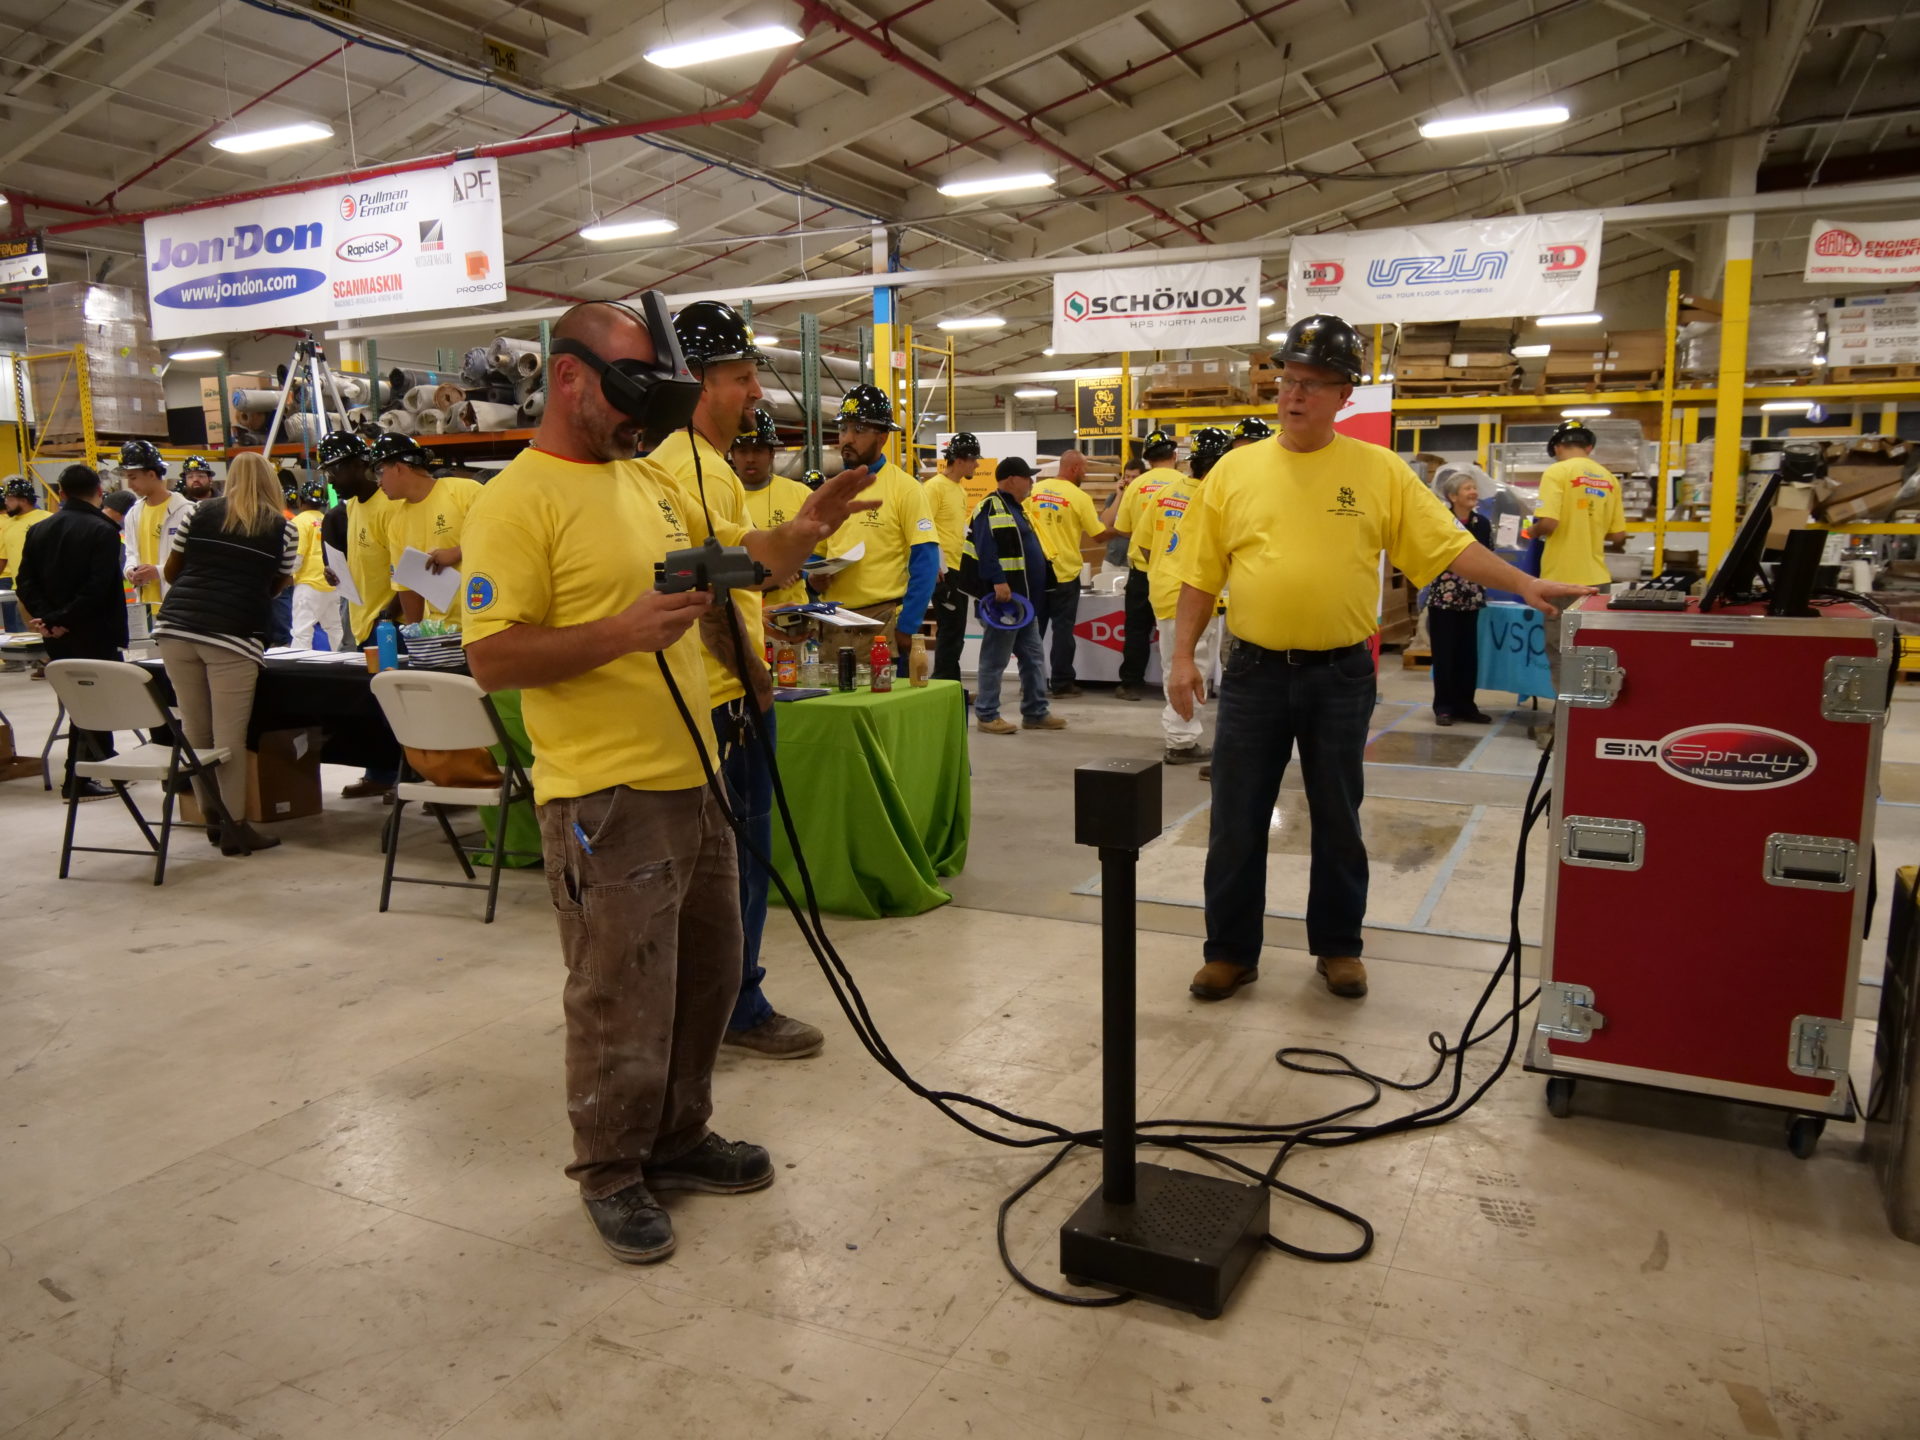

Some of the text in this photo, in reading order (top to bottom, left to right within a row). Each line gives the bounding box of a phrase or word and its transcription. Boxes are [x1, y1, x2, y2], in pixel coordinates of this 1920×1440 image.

[453, 169, 491, 203] APF
[359, 189, 408, 206] Pullman
[360, 202, 409, 217] Ermator
[347, 240, 388, 257] Rapid Set
[1865, 238, 1920, 249] ENGINE
[1539, 252, 1566, 265] BIG
[1546, 245, 1588, 271] D
[1302, 269, 1328, 280] BIG
[1308, 262, 1344, 286] D
[181, 274, 297, 302] www.jondon.com
[332, 273, 403, 299] SCANMASKIN
[456, 281, 504, 294] PROSOCO
[1091, 286, 1247, 313] SCHÖNOX
[1130, 311, 1247, 328] HPS NORTH AMERICA
[1669, 743, 1799, 773] Spray
[1691, 767, 1773, 780] INDUSTRIAL
